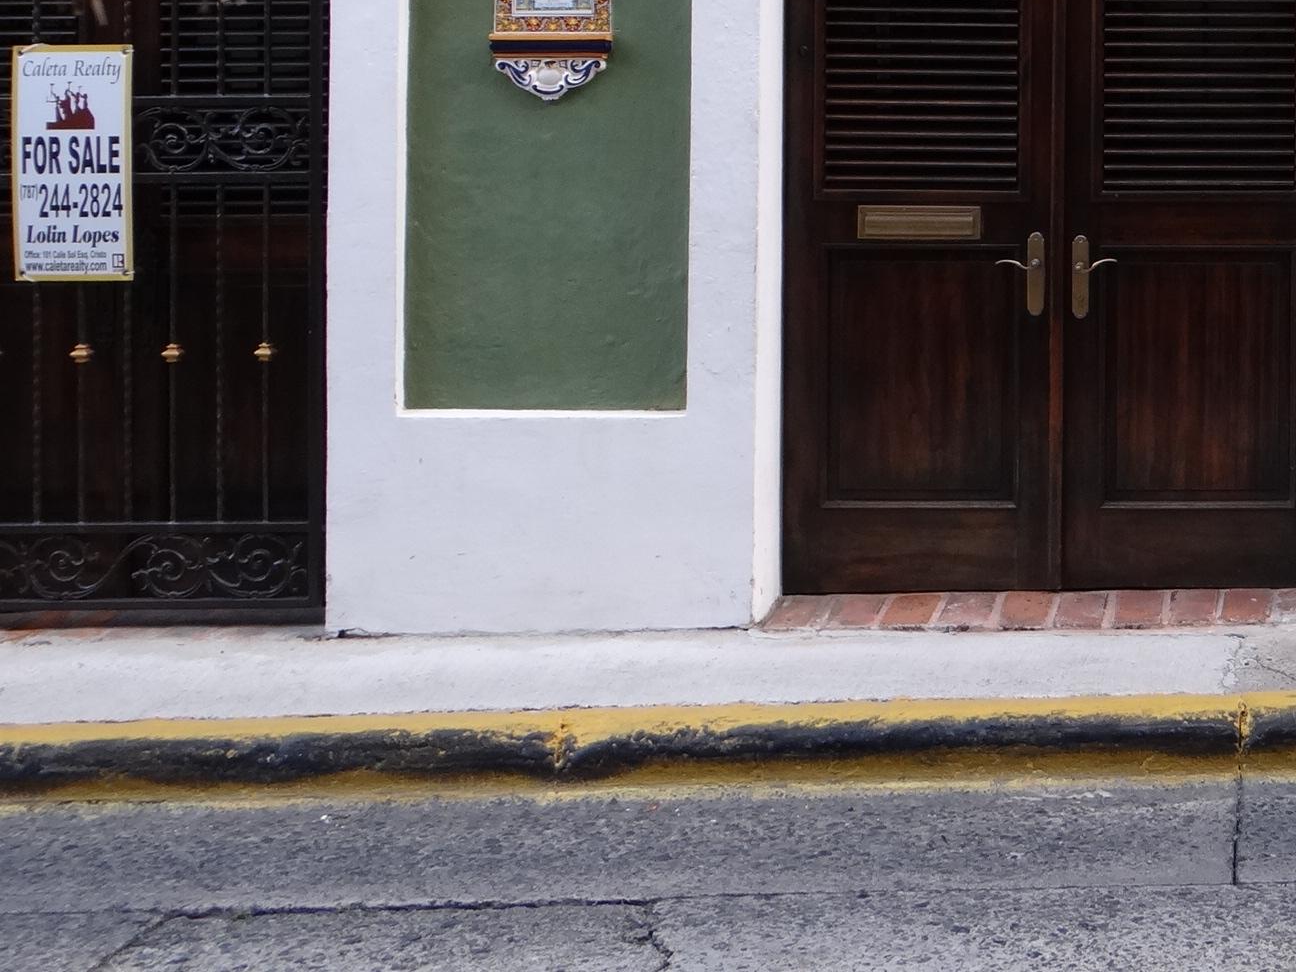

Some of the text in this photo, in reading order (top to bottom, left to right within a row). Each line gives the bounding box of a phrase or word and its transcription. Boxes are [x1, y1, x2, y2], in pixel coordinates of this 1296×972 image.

[22, 56, 122, 84] Caleta Realty
[22, 136, 120, 174] FOR SALE
[39, 183, 123, 218] 244-2824
[26, 225, 120, 247] Lolin Lopes
[25, 260, 107, 274] www.caletarealty.com
